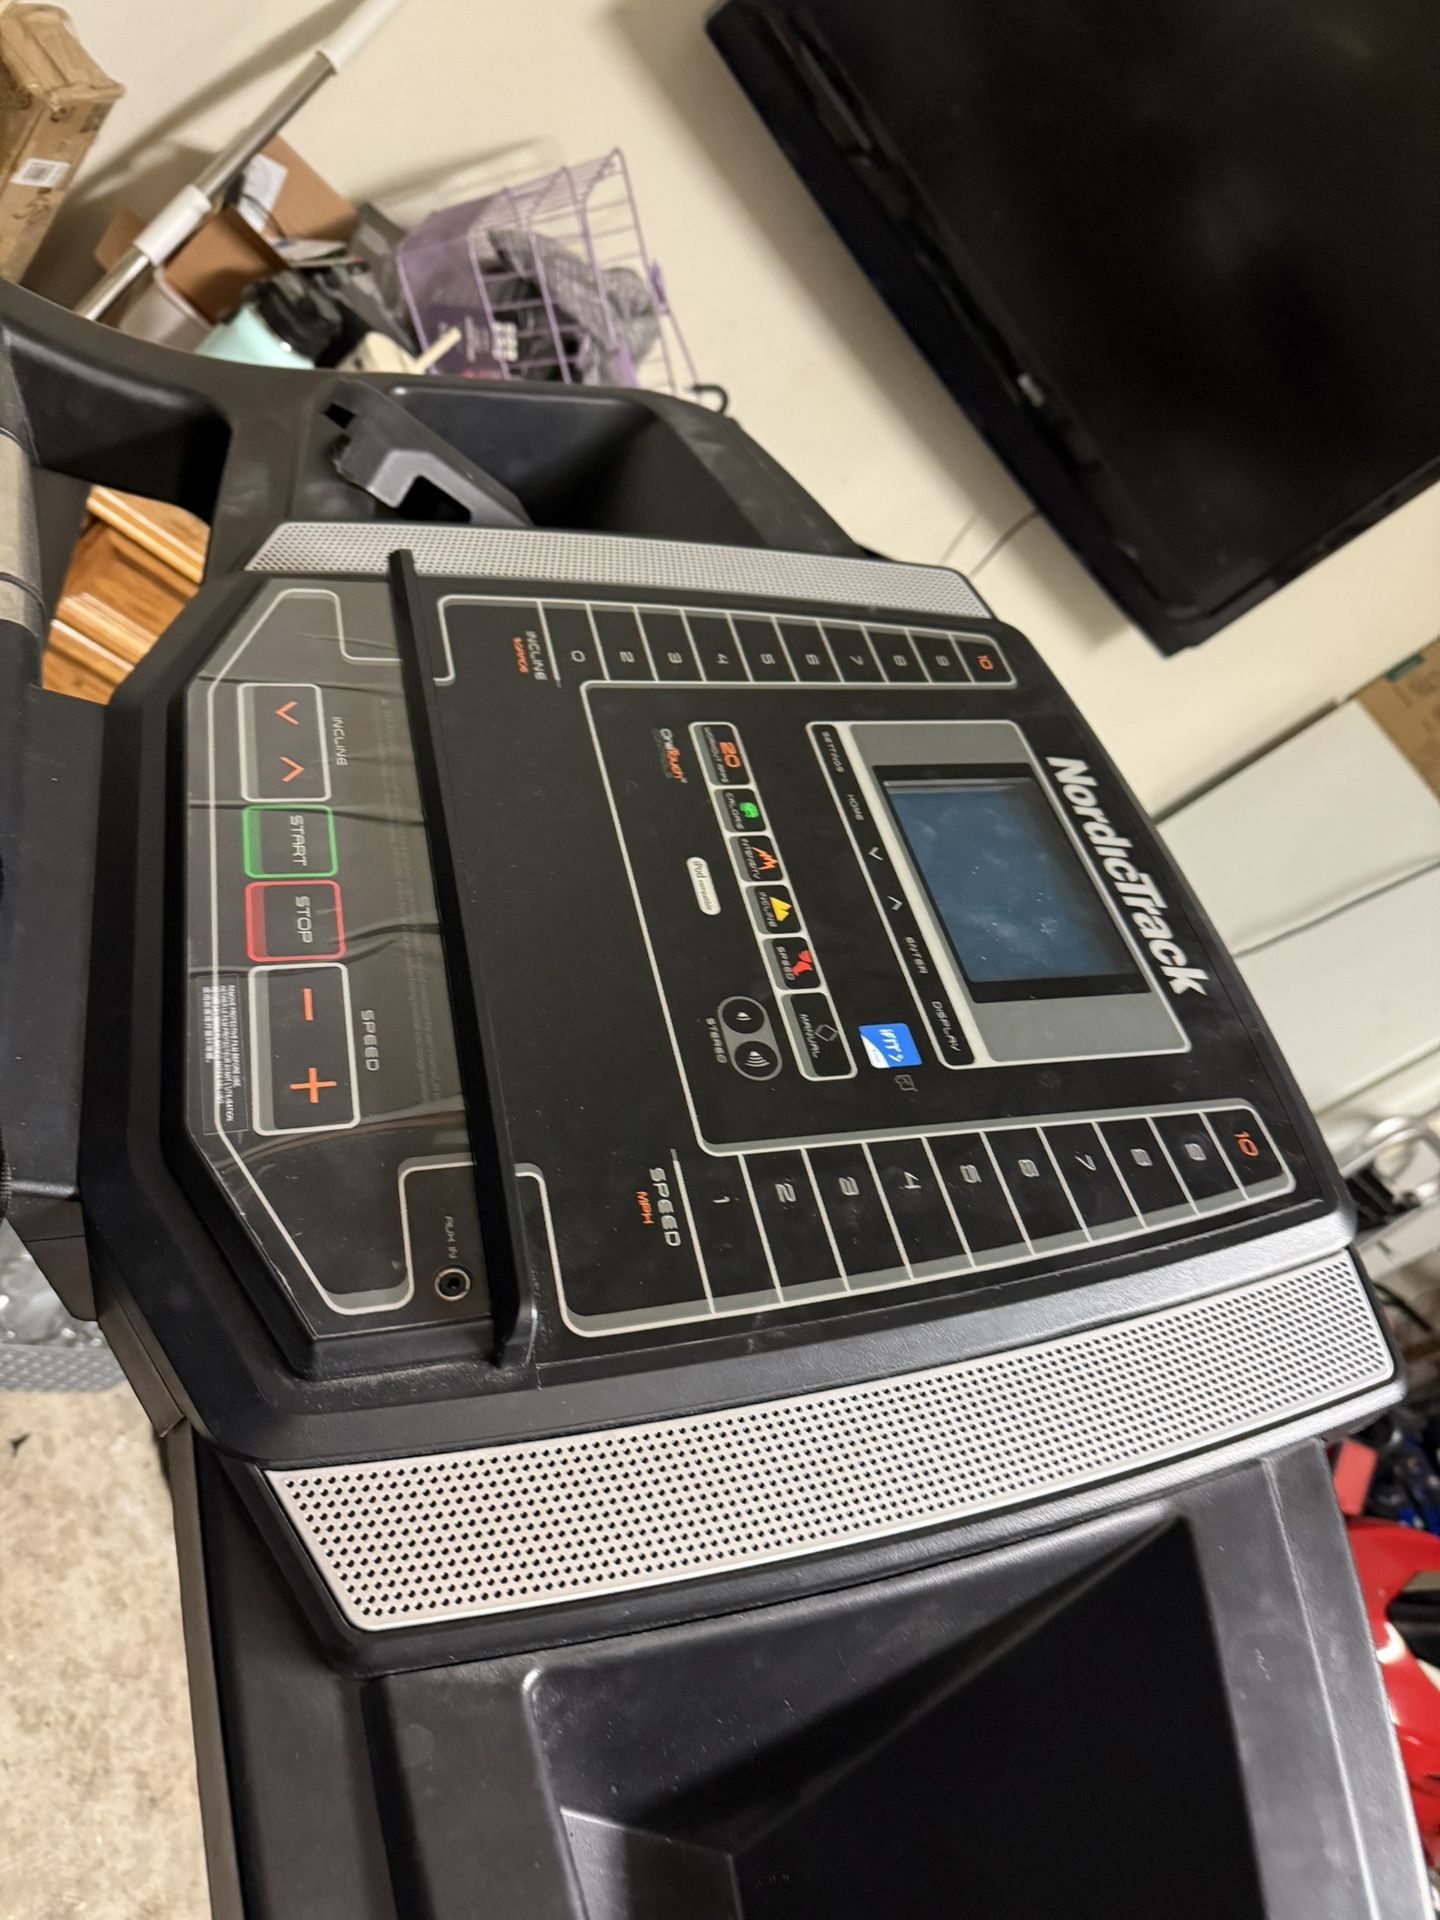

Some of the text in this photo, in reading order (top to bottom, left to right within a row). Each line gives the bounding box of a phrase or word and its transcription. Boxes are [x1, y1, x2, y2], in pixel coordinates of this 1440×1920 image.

[525, 630, 548, 681] INCLINE
[570, 650, 586, 662] 0
[619, 651, 635, 663] 2
[667, 652, 683, 664] 3
[717, 653, 730, 664] 4
[760, 653, 776, 665] 5
[804, 654, 820, 666] 6
[849, 655, 864, 666] 7
[892, 655, 907, 667] 8
[935, 655, 950, 667] 9
[976, 655, 994, 671] 10
[331, 716, 348, 767] INCLINE
[821, 731, 844, 773] SETTINGS
[719, 741, 741, 768] 20
[846, 793, 864, 821] HOME
[289, 815, 308, 867] START
[1045, 756, 1210, 996] NordicTrack
[295, 895, 313, 944] STOP
[776, 945, 796, 981] SPEED
[904, 936, 929, 974] ENTER
[799, 1013, 819, 1059] MANUAL
[932, 1001, 961, 1052] DISPLAY
[361, 1009, 380, 1071] SPEED
[705, 1017, 728, 1064] STEREO
[1234, 1131, 1259, 1157] 10
[1018, 1159, 1040, 1178] 6
[1075, 1153, 1097, 1171] 7
[1130, 1148, 1153, 1167] 8
[903, 1171, 922, 1189] 4
[959, 1164, 982, 1184] 5
[775, 1182, 797, 1203] 2
[838, 1176, 860, 1196] 3
[636, 1191, 655, 1225] MPH
[650, 1167, 682, 1247] SPEED
[712, 1195, 731, 1204] 1
[443, 1214, 459, 1260] AUX IN
